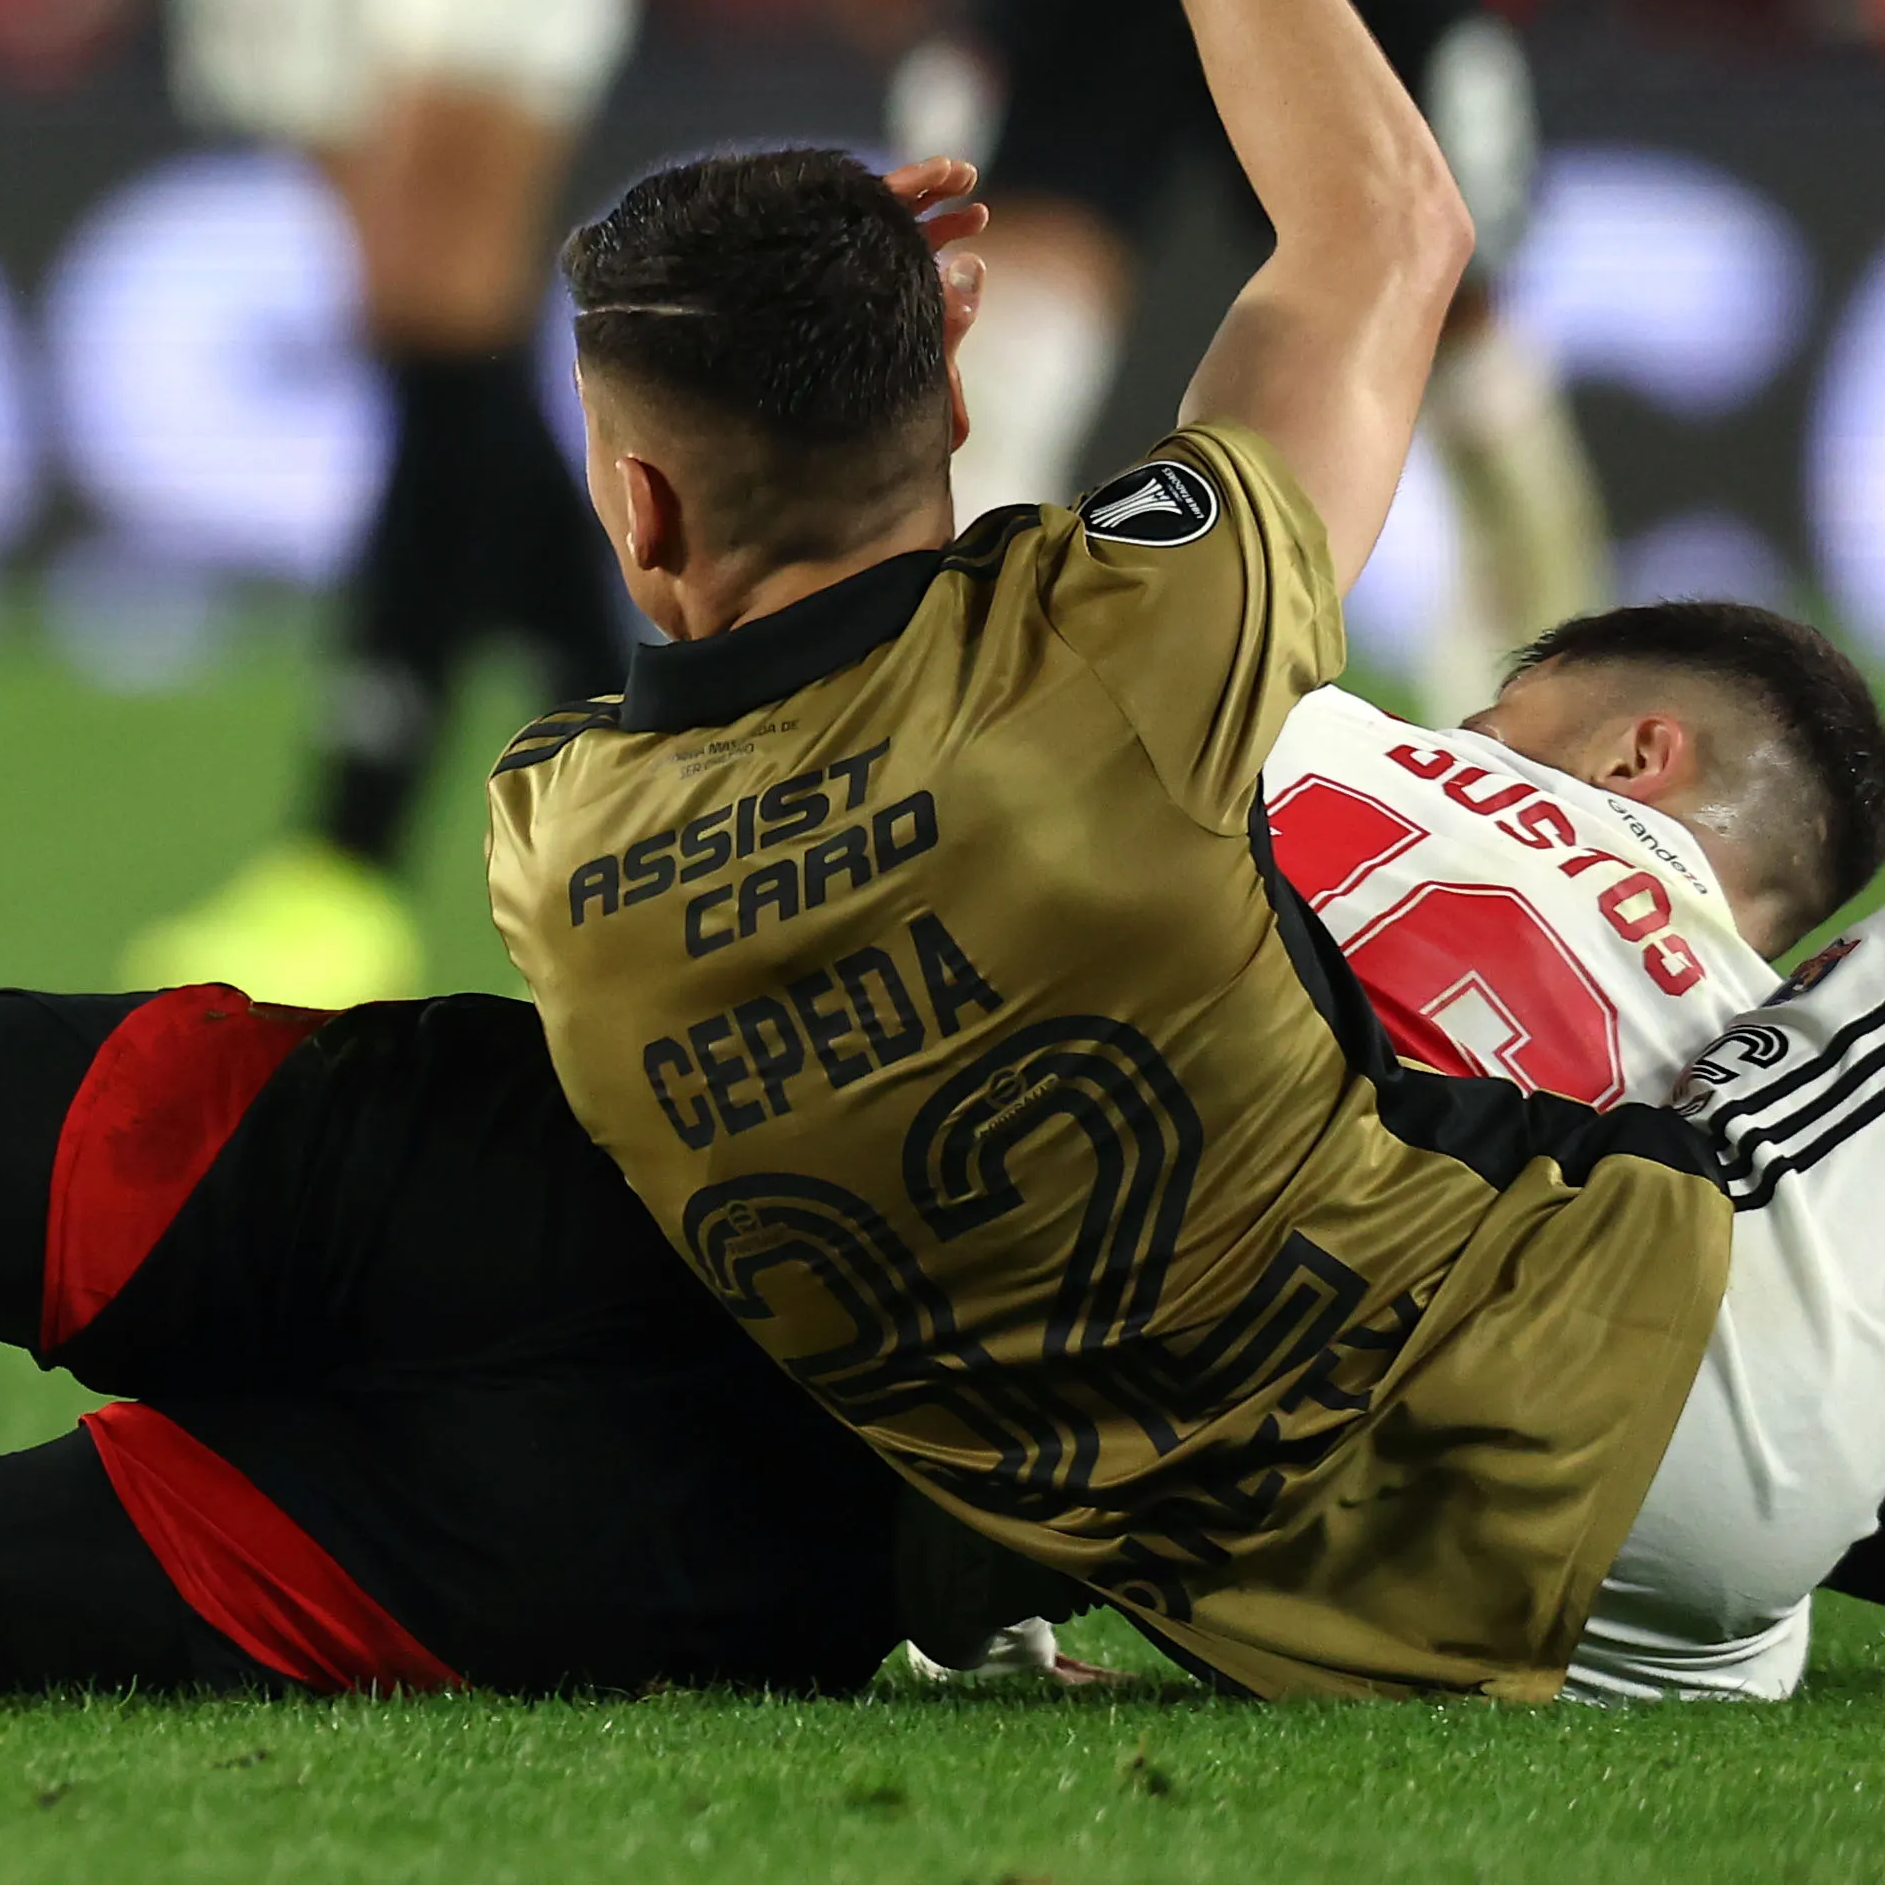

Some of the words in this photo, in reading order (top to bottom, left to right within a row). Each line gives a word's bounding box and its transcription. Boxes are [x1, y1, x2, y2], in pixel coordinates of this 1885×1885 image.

[568, 736, 890, 927] ASSIST
[684, 790, 939, 958] CARD
[643, 909, 1005, 1151] CEPEDA
